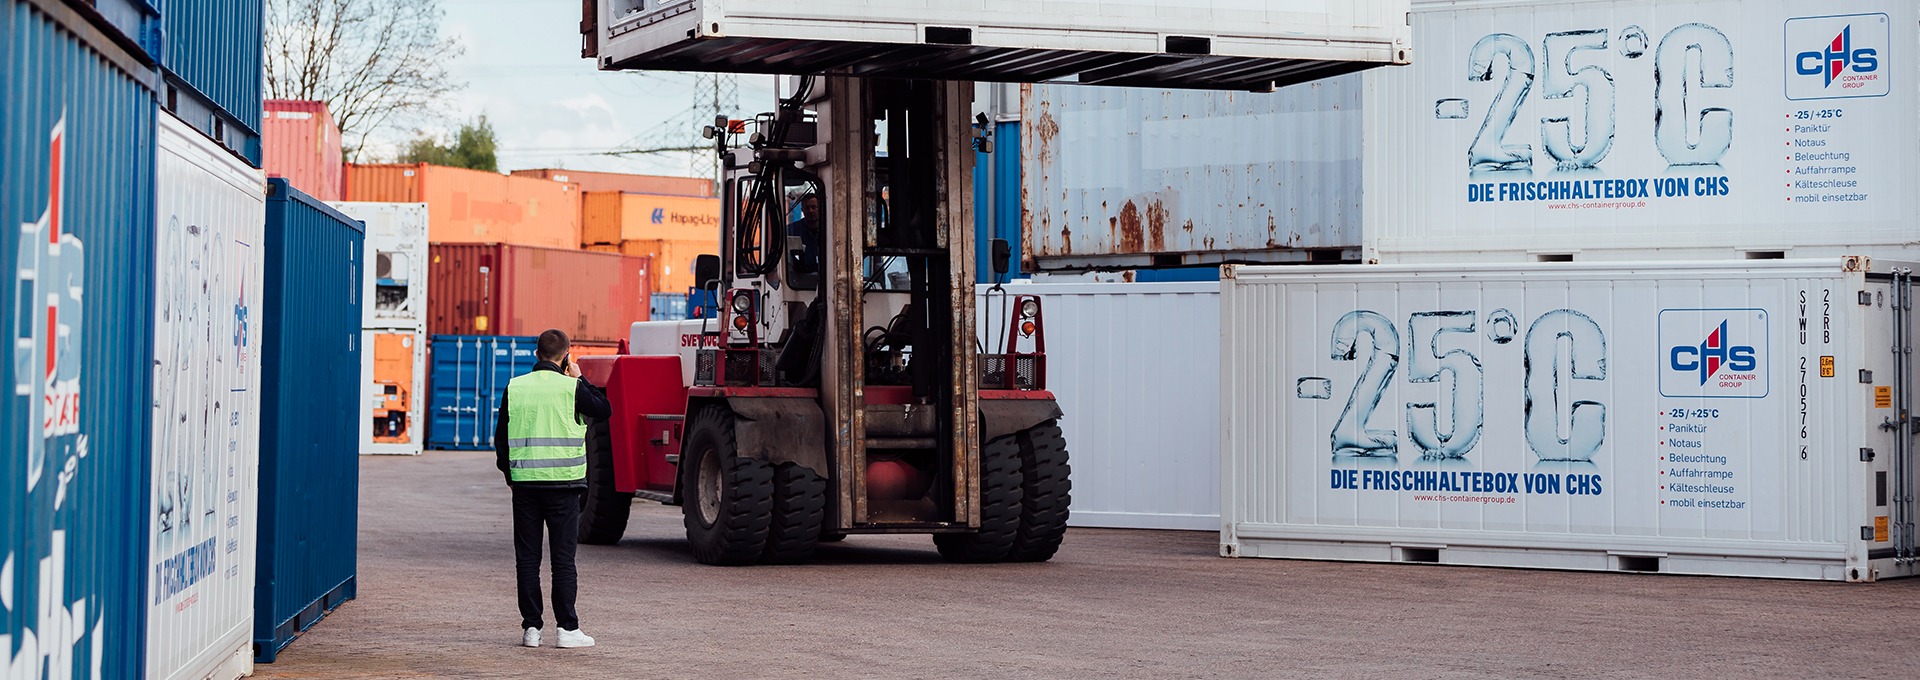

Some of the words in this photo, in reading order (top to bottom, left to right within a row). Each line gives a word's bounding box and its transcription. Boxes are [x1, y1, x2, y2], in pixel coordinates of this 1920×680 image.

[1796, 23, 1878, 89] CHS
[1794, 124, 1831, 133] Paniktür
[1794, 139, 1826, 147] Notaus
[1794, 152, 1850, 161] Beleuchtung
[1794, 166, 1856, 175] Auffahrrampe
[1468, 183, 1494, 202] DIE
[1499, 179, 1649, 201] FRISCHHALTEBOX
[1653, 177, 1689, 198] VON
[1694, 175, 1729, 196] CHS
[1795, 179, 1857, 189] Kälteschleuse
[1795, 193, 1820, 203] mobil
[1822, 193, 1868, 202] einsetzbar
[1547, 200, 1646, 210] www.chs-containergroup.de
[1799, 290, 1807, 345] SVWU
[681, 334, 720, 347] SVETRUC
[1670, 318, 1756, 387] CHS
[1669, 423, 1707, 433] Paniktür
[1669, 438, 1702, 448] Notaus
[1669, 453, 1727, 465] Beleuchtung
[1669, 468, 1734, 480] Auffahrrampe
[1331, 469, 1358, 490] DIE
[1362, 469, 1519, 493] FRISCHHALTEBOX
[1523, 473, 1560, 495] VON
[1566, 474, 1602, 496] CHS
[1669, 483, 1734, 493] Kälteschleuse
[1414, 494, 1515, 504] www.chs-containergroup.de
[1669, 498, 1695, 507] mobil
[1697, 499, 1745, 509] einsetzbar
